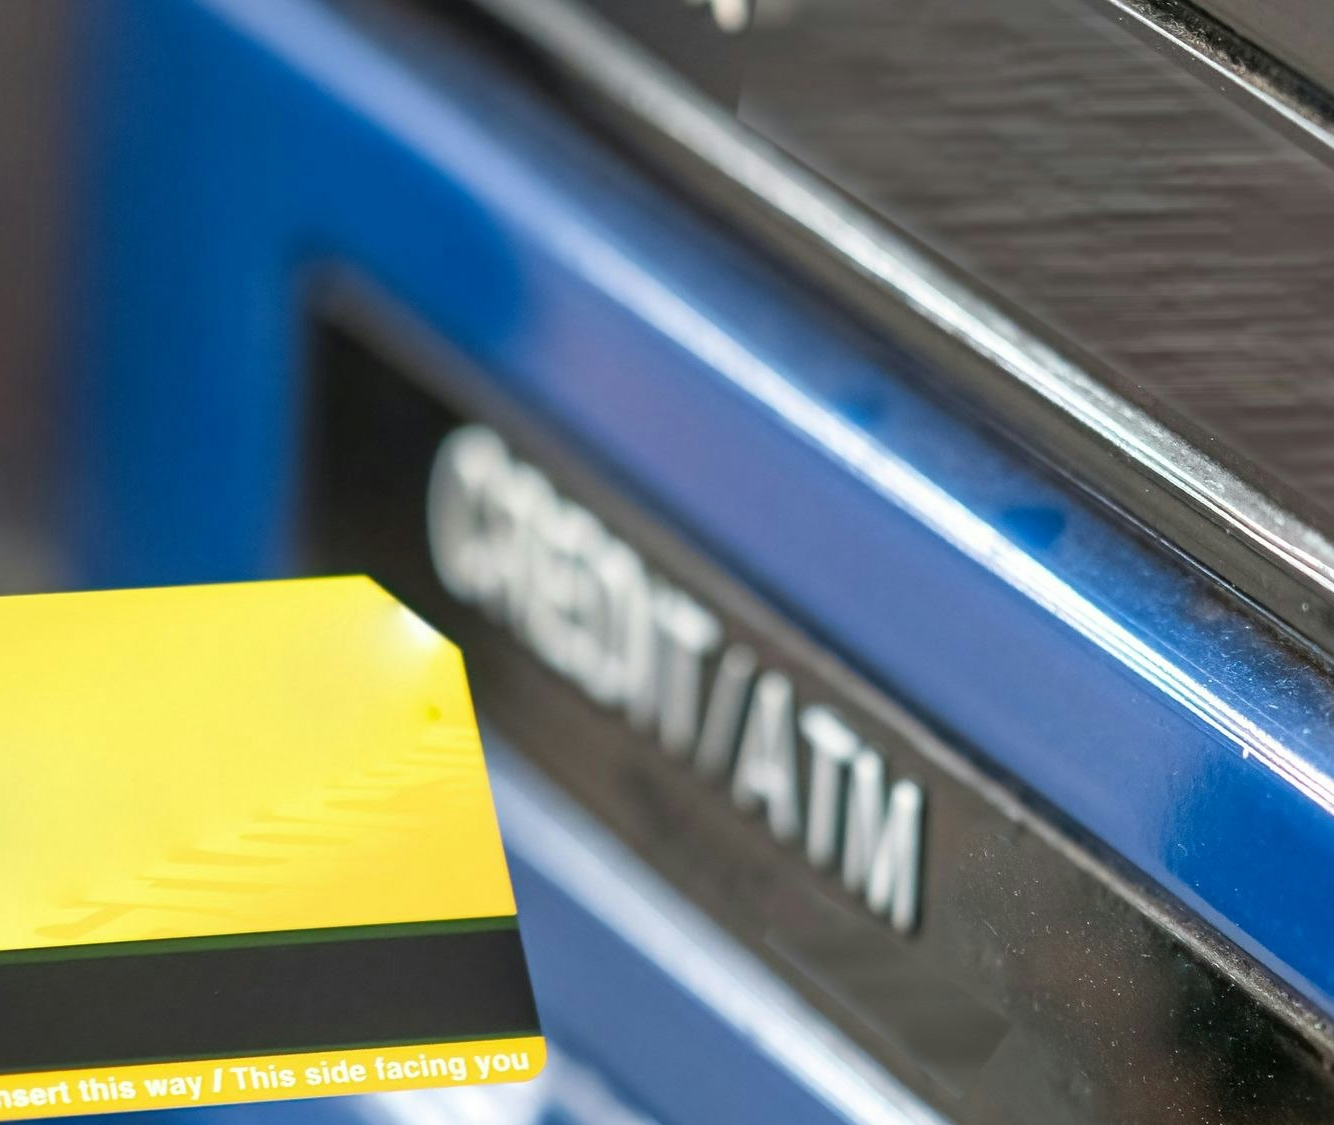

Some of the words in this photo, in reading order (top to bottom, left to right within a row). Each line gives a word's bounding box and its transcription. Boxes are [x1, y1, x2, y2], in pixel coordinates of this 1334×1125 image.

[427, 424, 922, 934] CREDIT/ATM
[78, 1076, 136, 1102] this
[144, 1075, 202, 1101] way
[230, 1065, 296, 1090] This
[304, 1061, 367, 1085] side
[374, 1053, 468, 1081] facing
[474, 1052, 529, 1079] you
